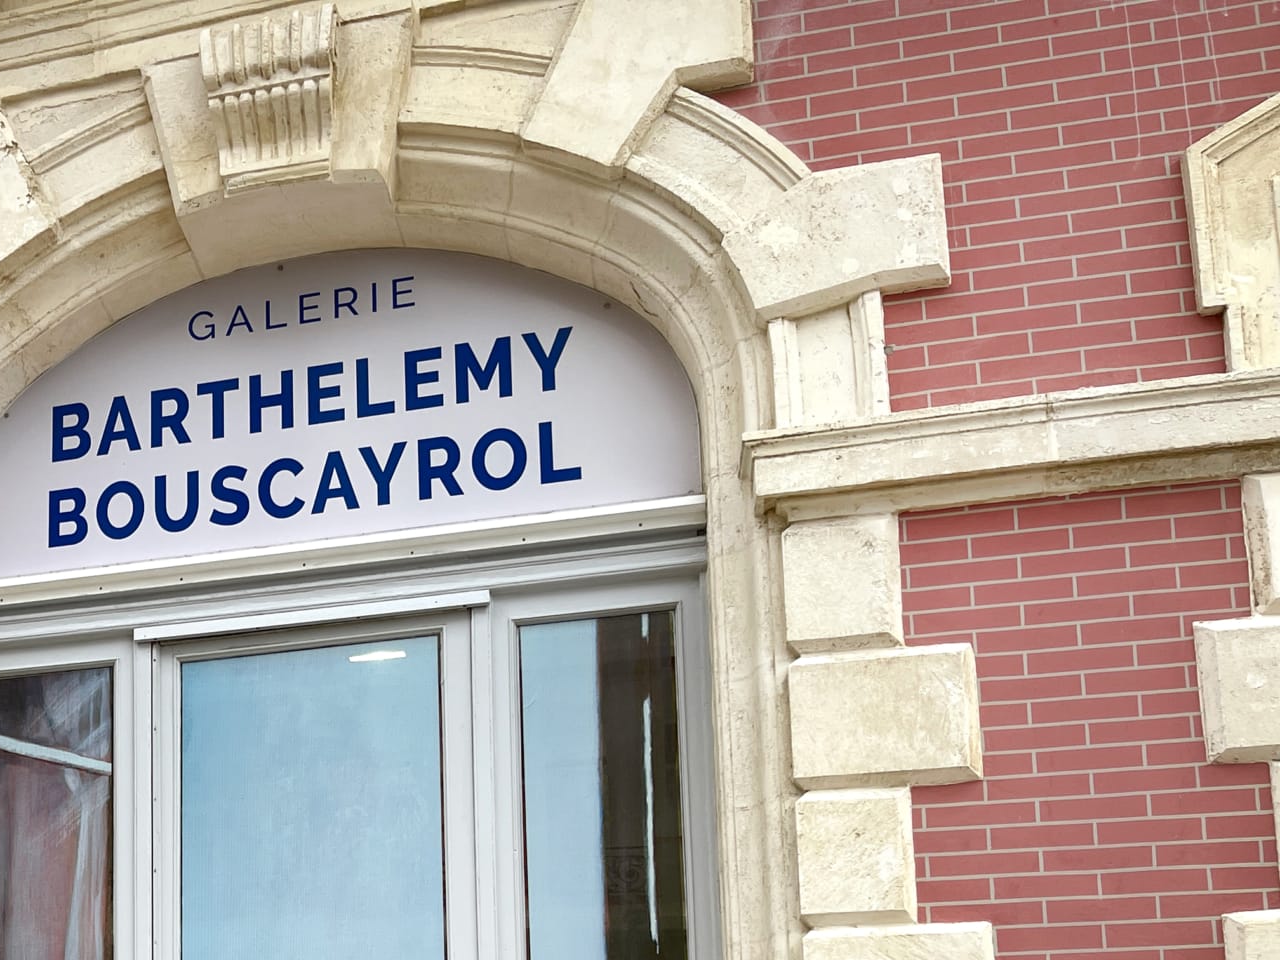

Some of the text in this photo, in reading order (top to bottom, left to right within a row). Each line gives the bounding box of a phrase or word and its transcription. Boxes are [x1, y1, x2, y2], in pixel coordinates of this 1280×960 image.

[188, 275, 415, 340] GALERIE
[52, 326, 573, 462] BARTHELEMY
[48, 422, 583, 548] BOUSCAYROL
